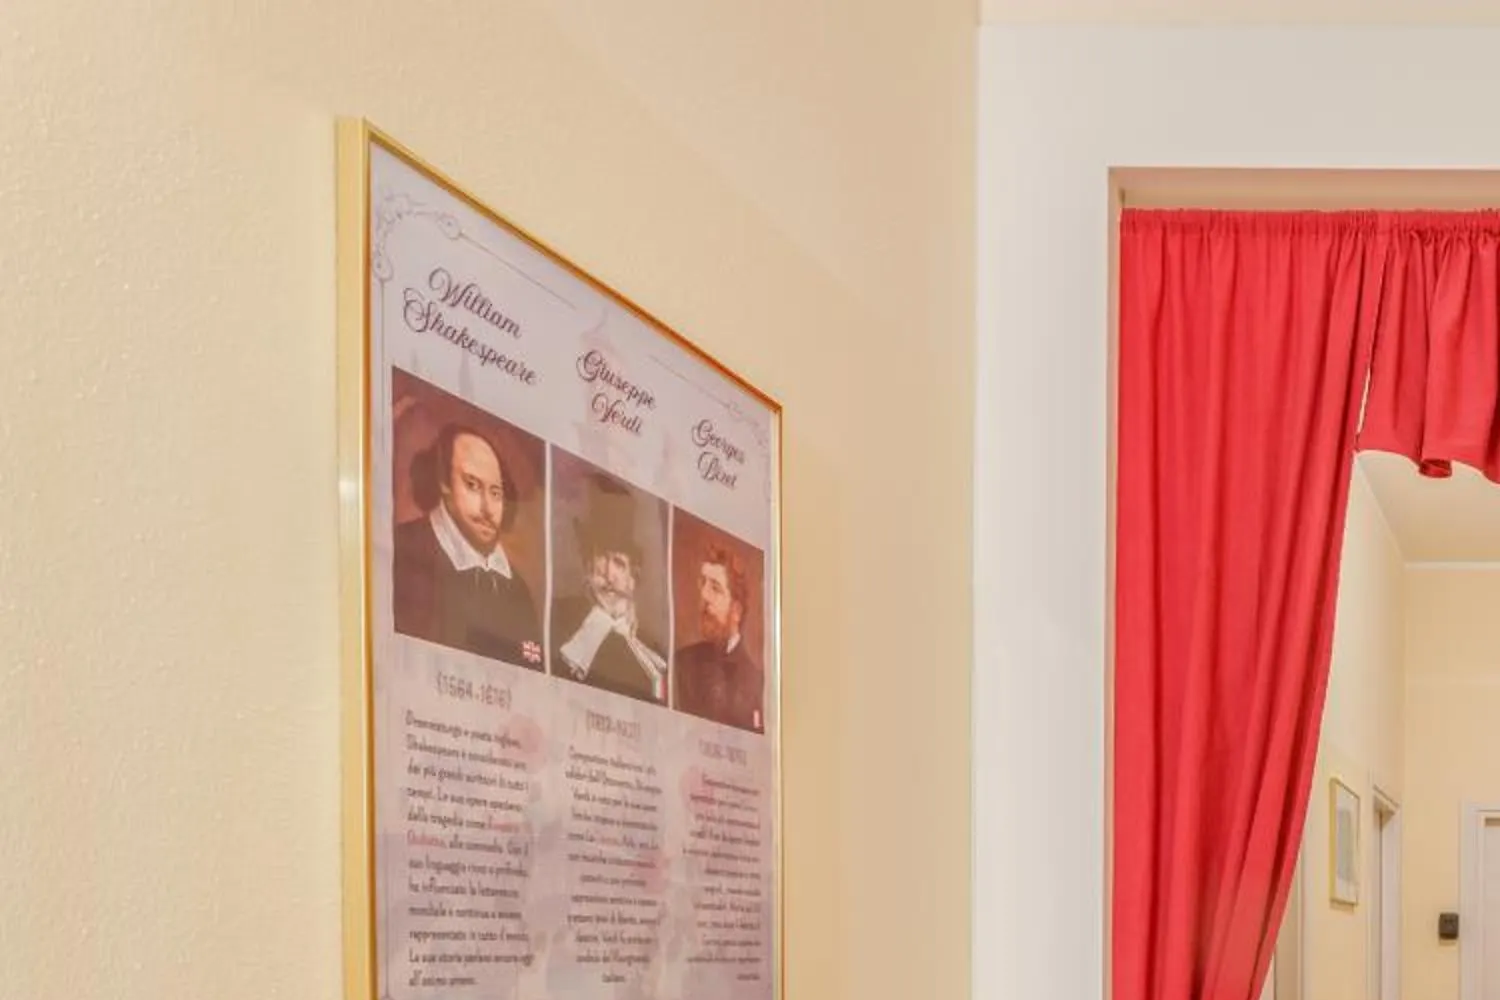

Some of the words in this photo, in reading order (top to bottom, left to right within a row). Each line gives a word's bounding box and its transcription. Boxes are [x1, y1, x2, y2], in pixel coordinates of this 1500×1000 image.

[428, 267, 522, 340] William
[403, 287, 538, 386] Shakespeare
[576, 350, 656, 409] Giuseppe
[591, 393, 643, 437] Verdi
[692, 419, 745, 466] Georges
[698, 452, 738, 490] Bizet
